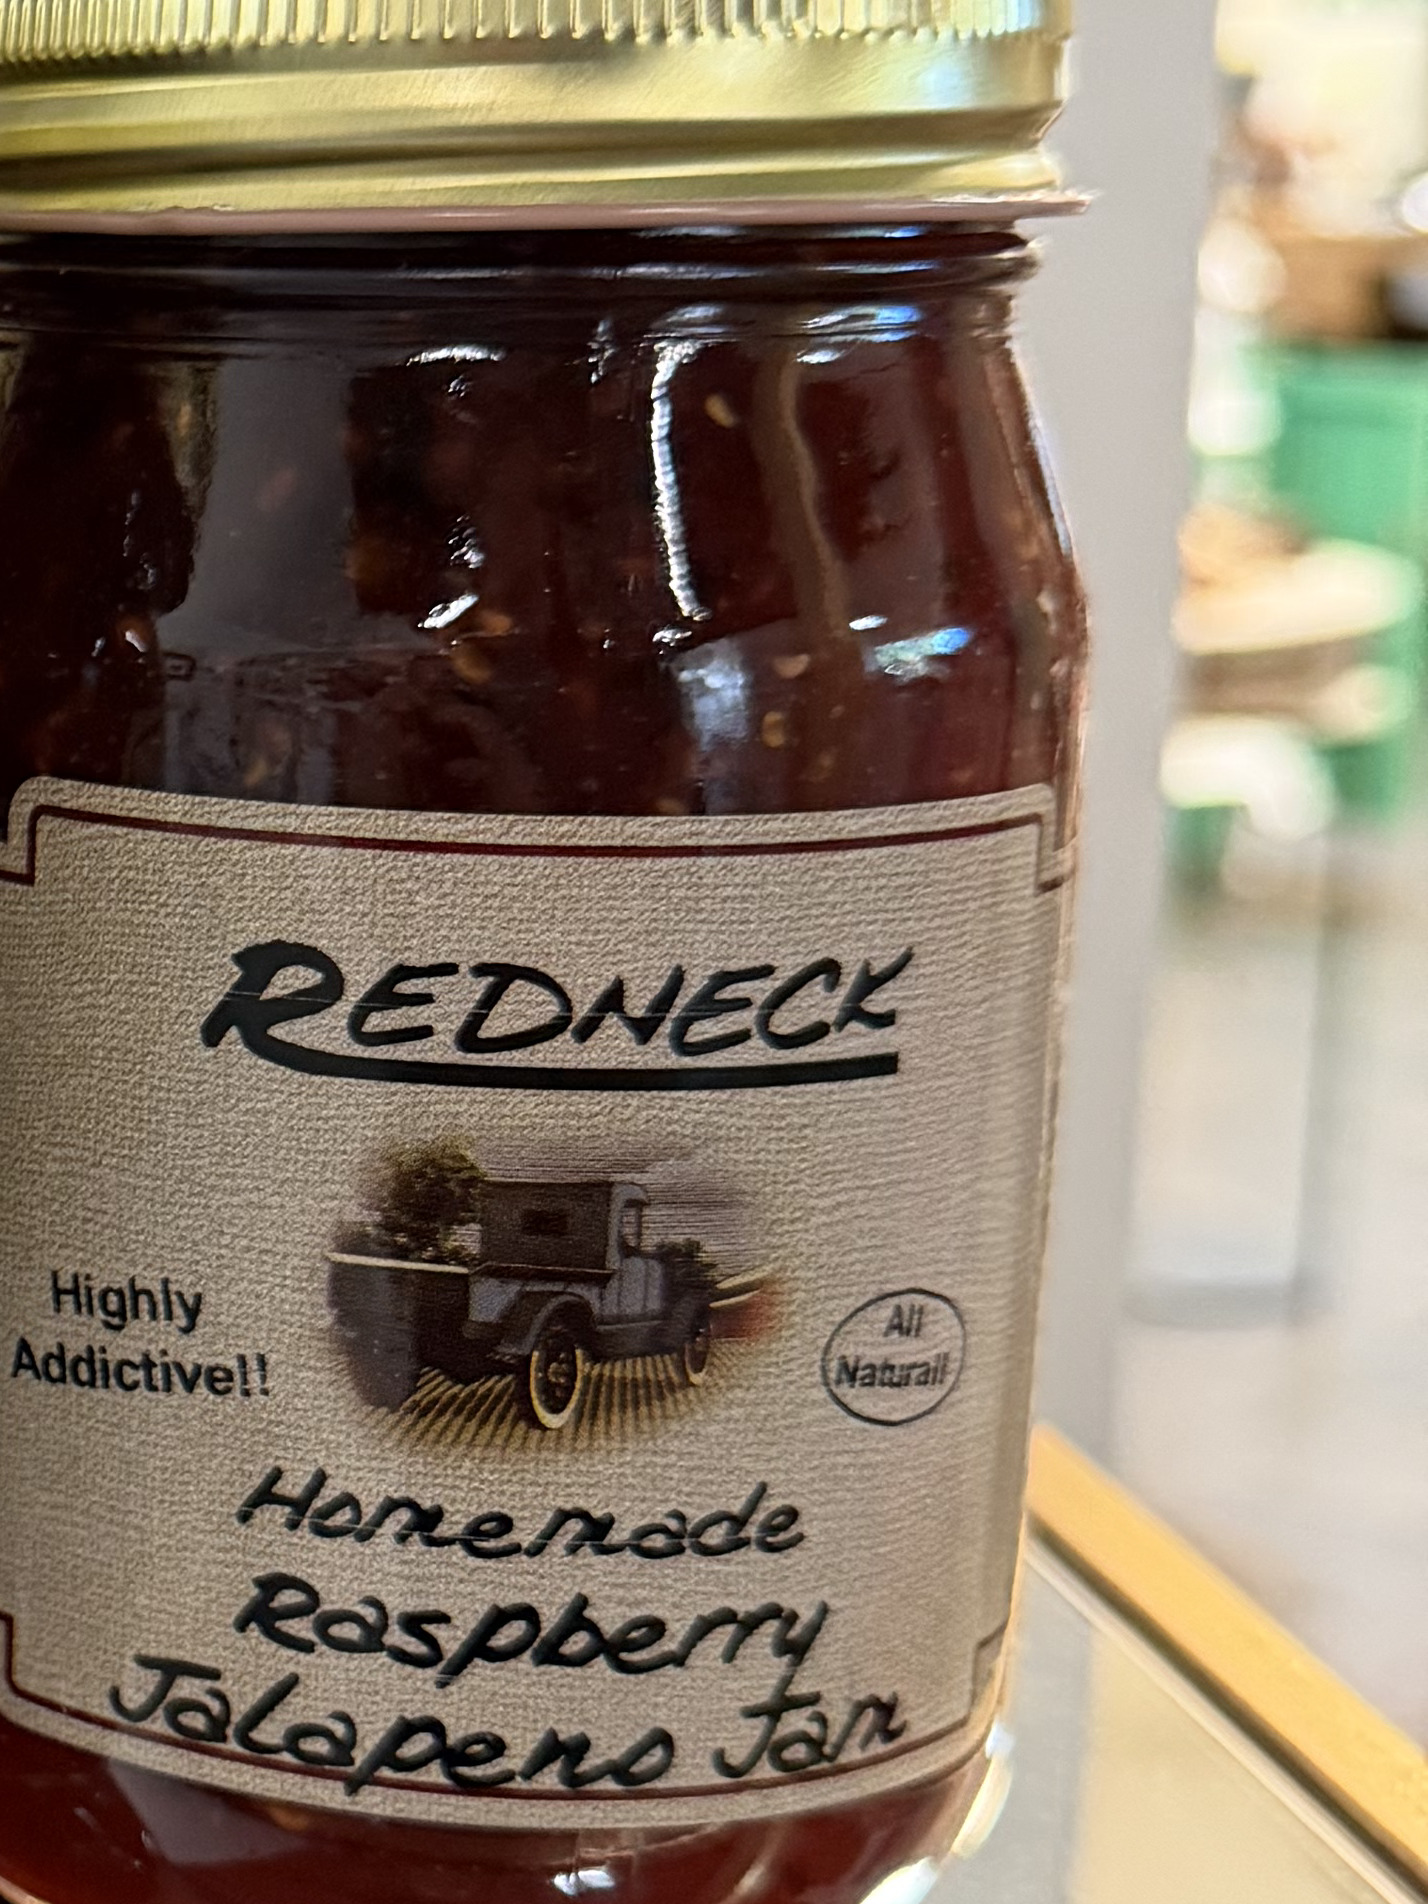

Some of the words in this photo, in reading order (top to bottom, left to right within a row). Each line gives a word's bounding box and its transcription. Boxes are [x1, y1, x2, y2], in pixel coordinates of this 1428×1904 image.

[200, 939, 913, 1092] REDNECK
[50, 1270, 203, 1335] Highly
[884, 1303, 923, 1341] All
[11, 1338, 270, 1398] Addictive!!
[235, 1466, 805, 1560] Homemade
[234, 1571, 830, 1690] Raspberry
[109, 1654, 675, 1796] Jalapeno
[712, 1691, 908, 1779] Jam
